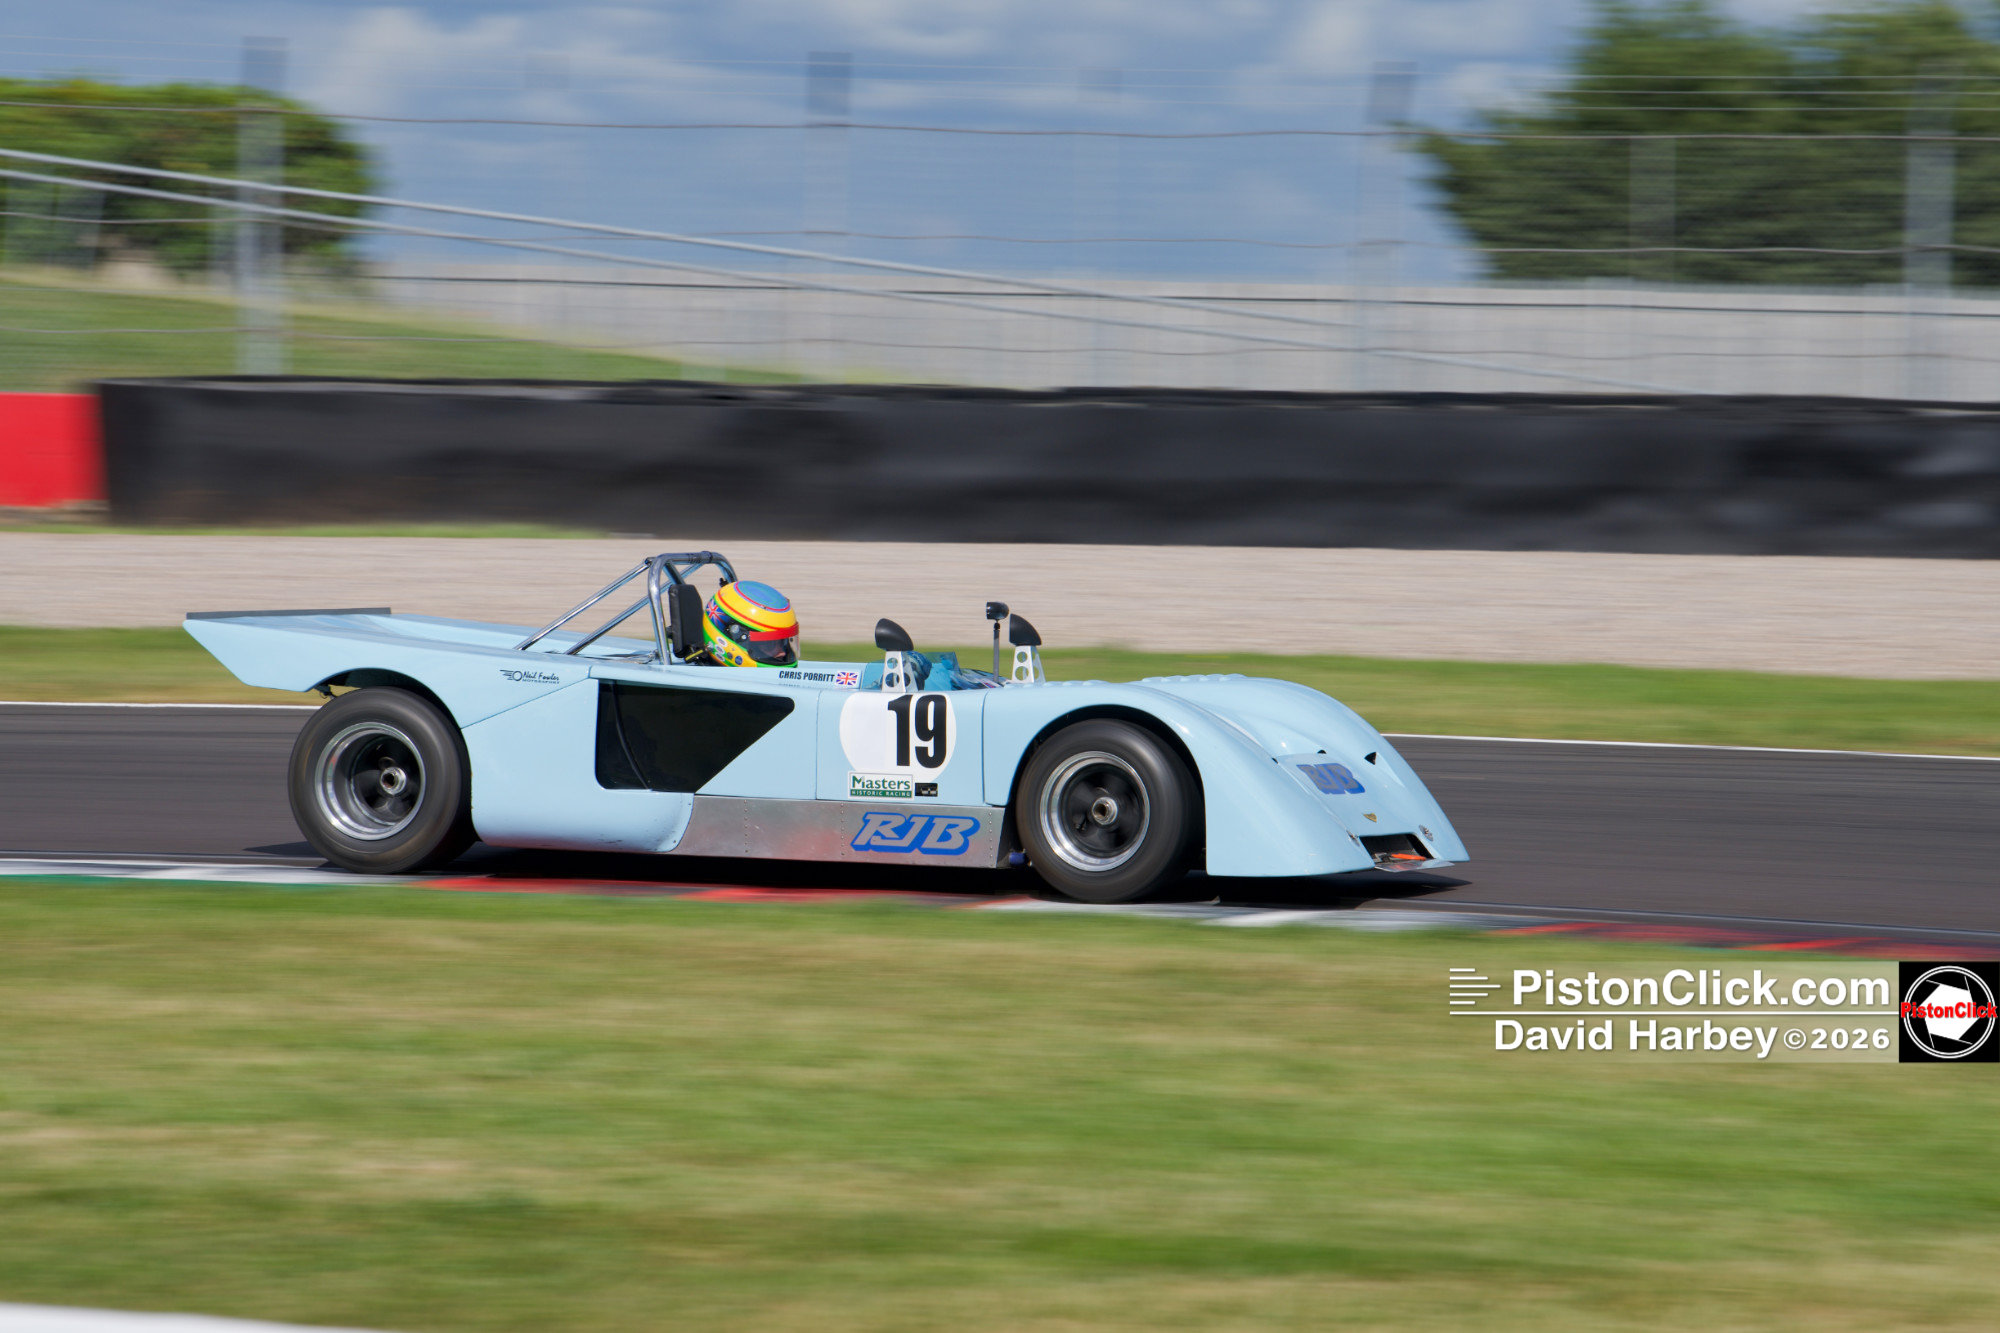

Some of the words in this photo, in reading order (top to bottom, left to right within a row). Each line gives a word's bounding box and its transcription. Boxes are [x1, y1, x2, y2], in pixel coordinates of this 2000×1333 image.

[779, 670, 802, 680] CHRIS
[803, 672, 835, 682] PORRITT
[887, 694, 947, 768] 19
[852, 775, 911, 790] Masters
[850, 812, 980, 855] RJB
